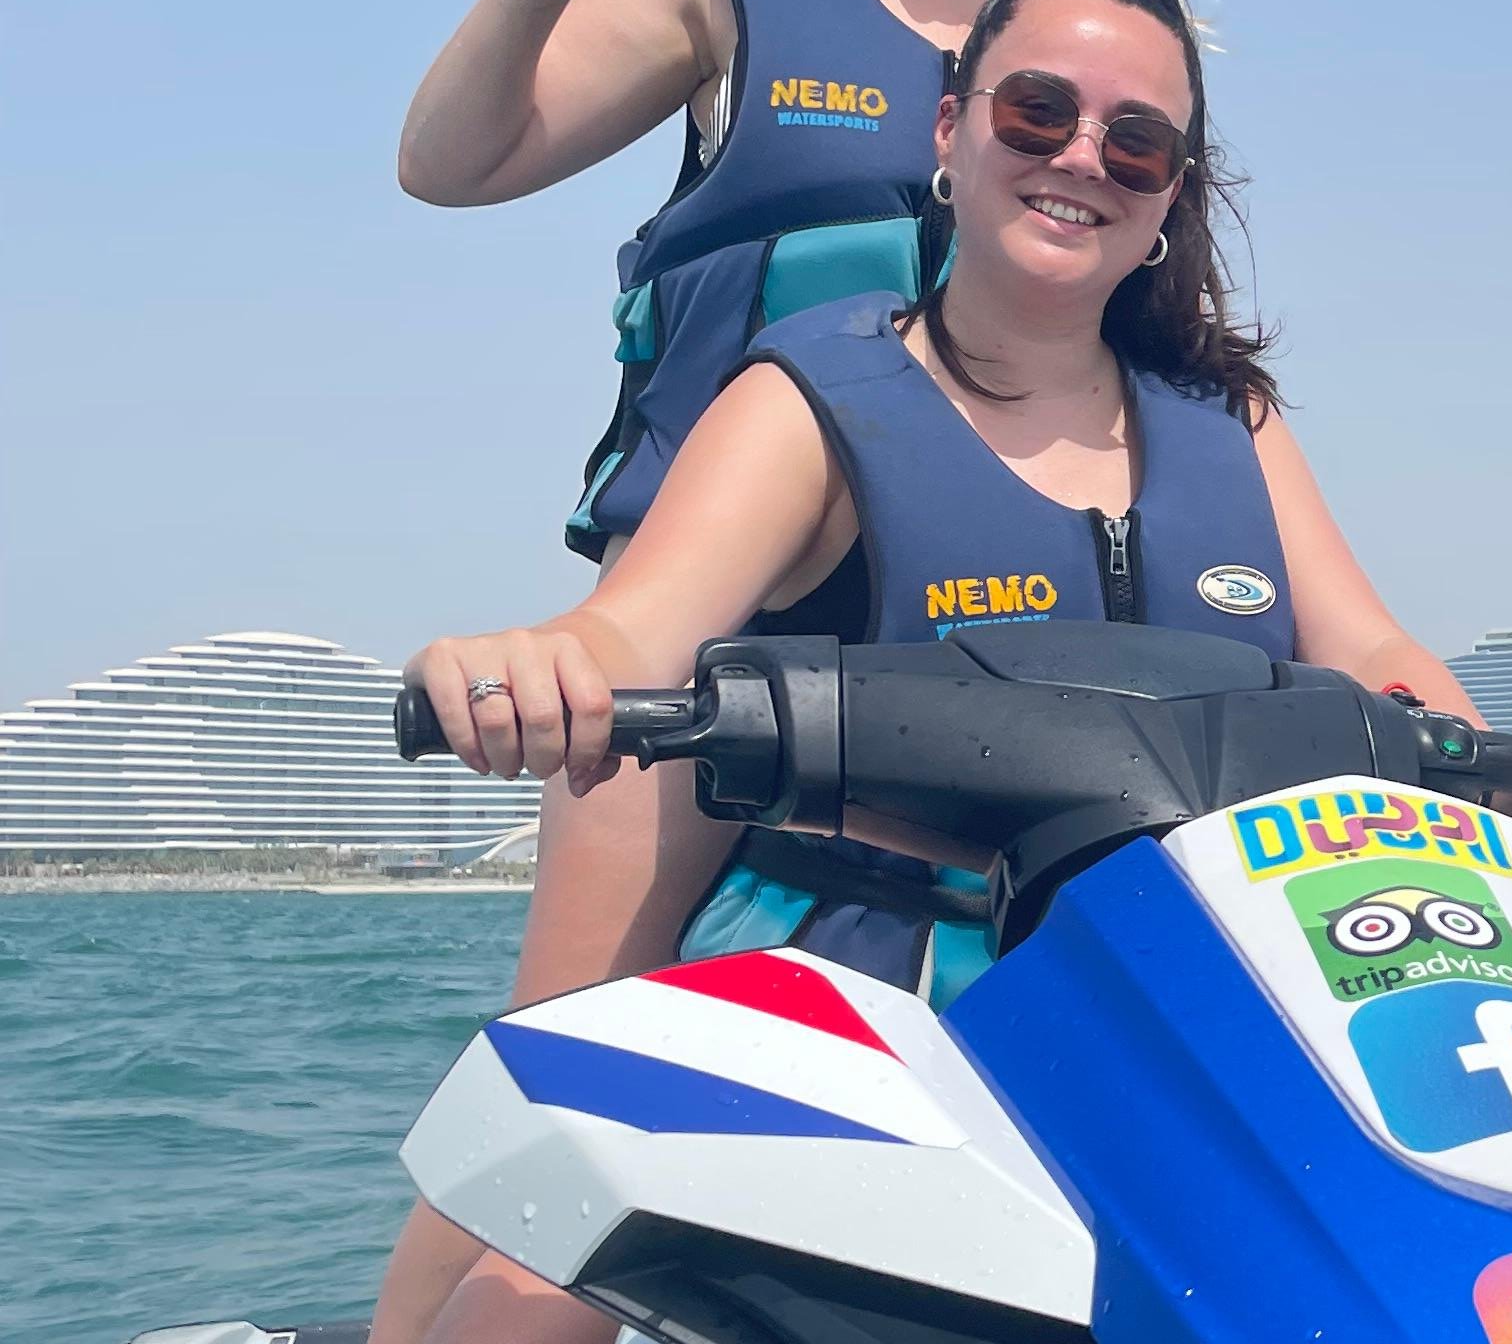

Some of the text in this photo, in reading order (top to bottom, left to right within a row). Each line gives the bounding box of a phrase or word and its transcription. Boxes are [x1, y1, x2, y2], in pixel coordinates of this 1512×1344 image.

[770, 78, 889, 117] NEMO
[777, 111, 880, 132] WATERSPORTS
[927, 574, 1058, 619] NEMO
